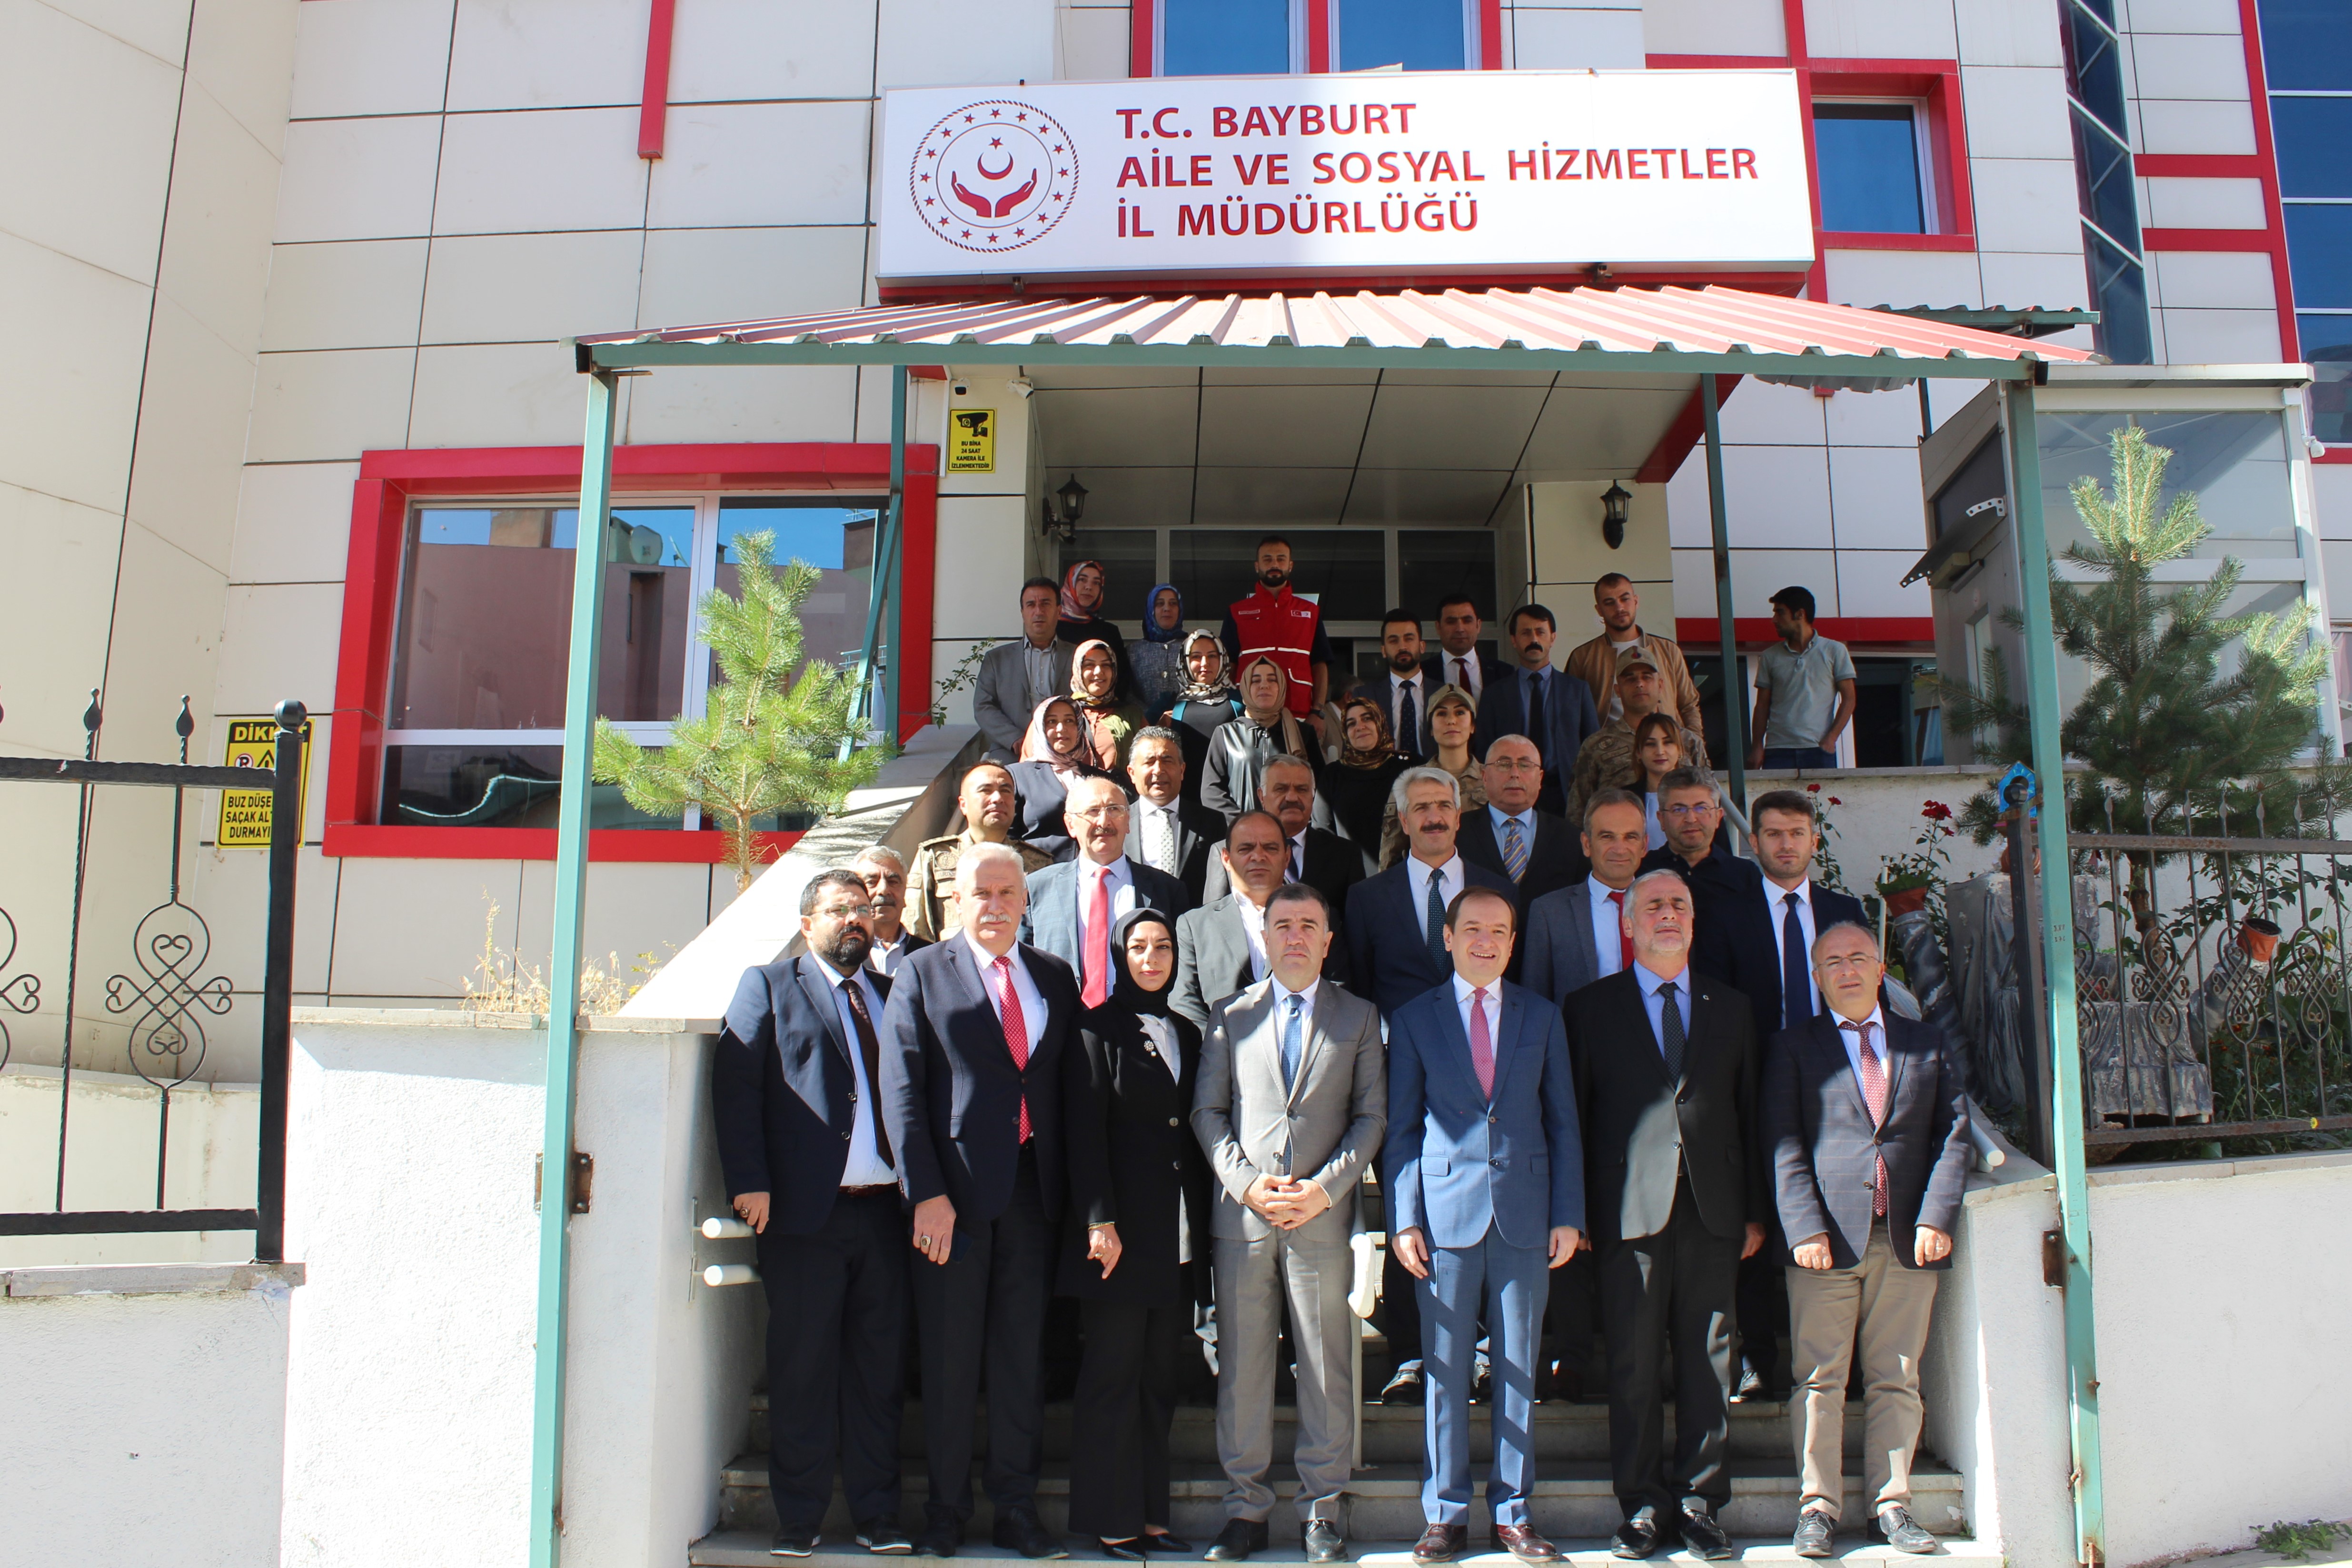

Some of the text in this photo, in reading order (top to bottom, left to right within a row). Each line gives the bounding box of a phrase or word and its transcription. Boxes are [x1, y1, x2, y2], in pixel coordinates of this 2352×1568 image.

[1116, 104, 1416, 139] T.C. BAYBURT
[1117, 142, 1758, 188] AİLE VE SOSYAL HİZMETLER
[1119, 192, 1478, 238] İL MÜDÜRLÜĞÜ
[234, 723, 308, 741] DİKK
[228, 793, 272, 809] BUZ DÜŞE
[226, 811, 272, 824] SAÇAK AL
[229, 826, 271, 838] DURMAYI
